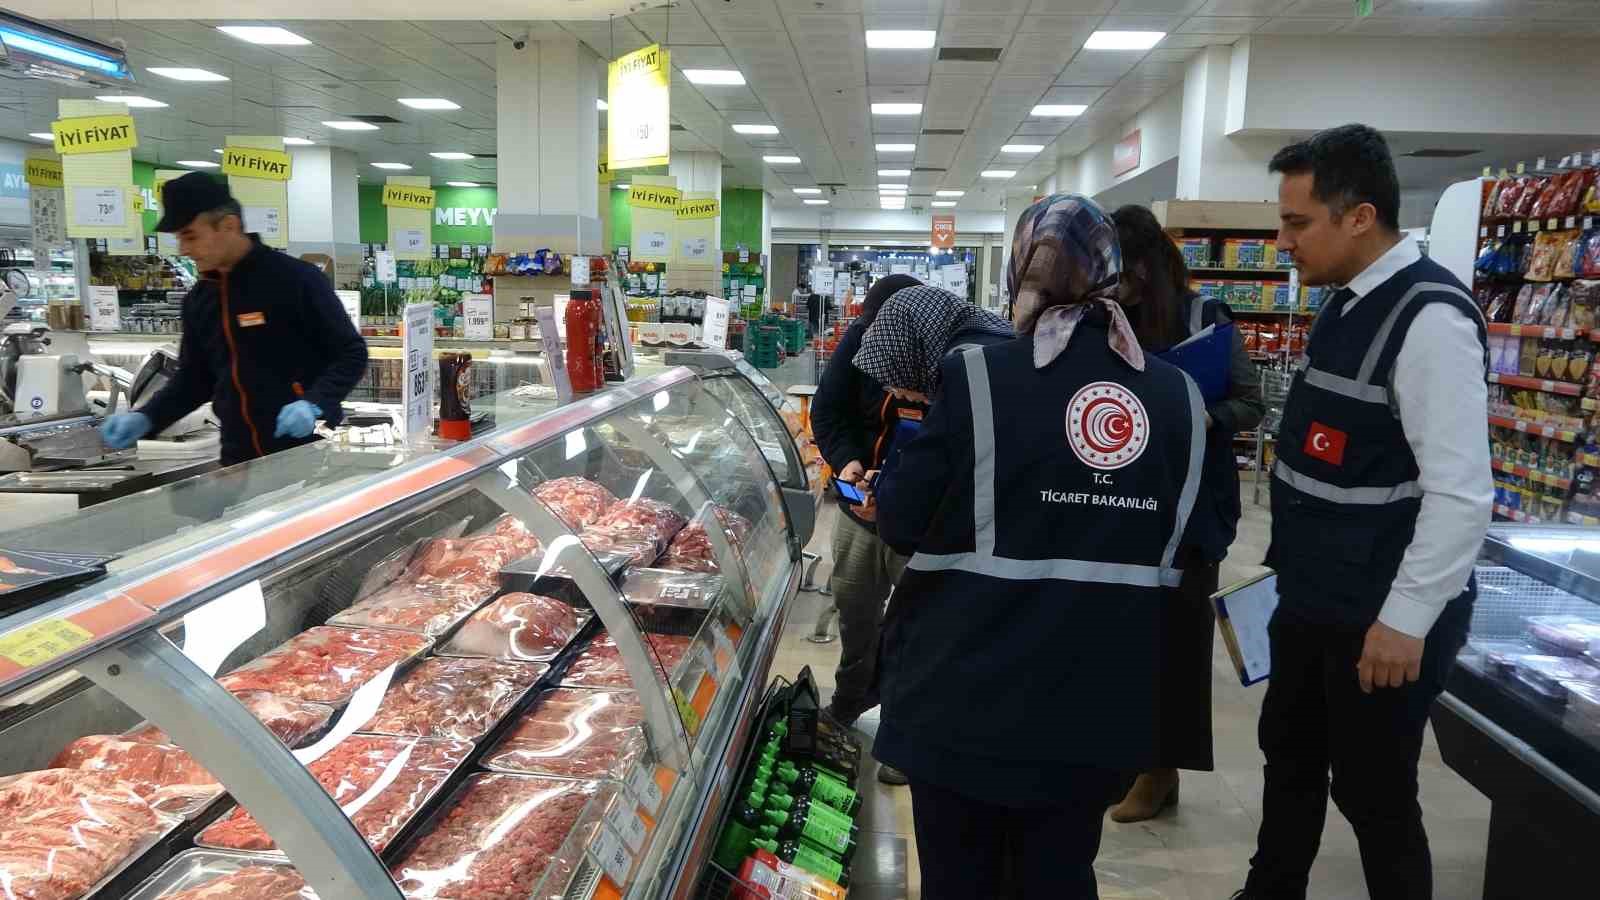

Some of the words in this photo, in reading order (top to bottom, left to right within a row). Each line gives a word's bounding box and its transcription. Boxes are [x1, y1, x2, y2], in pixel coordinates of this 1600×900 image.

[60, 128, 82, 147] İYİ
[85, 125, 129, 143] FİYAT
[227, 151, 245, 168] İYİ
[248, 156, 288, 174] FİYAT
[388, 188, 402, 200] İYİ
[404, 192, 433, 205] FİYAT
[632, 187, 646, 201] İYİ
[648, 192, 678, 206] FİYAT
[690, 202, 716, 214] FİYAT
[1092, 472, 1113, 485] T.C.
[1040, 489, 1090, 505] TİCARET
[1092, 493, 1158, 511] BAKANLIĞI
